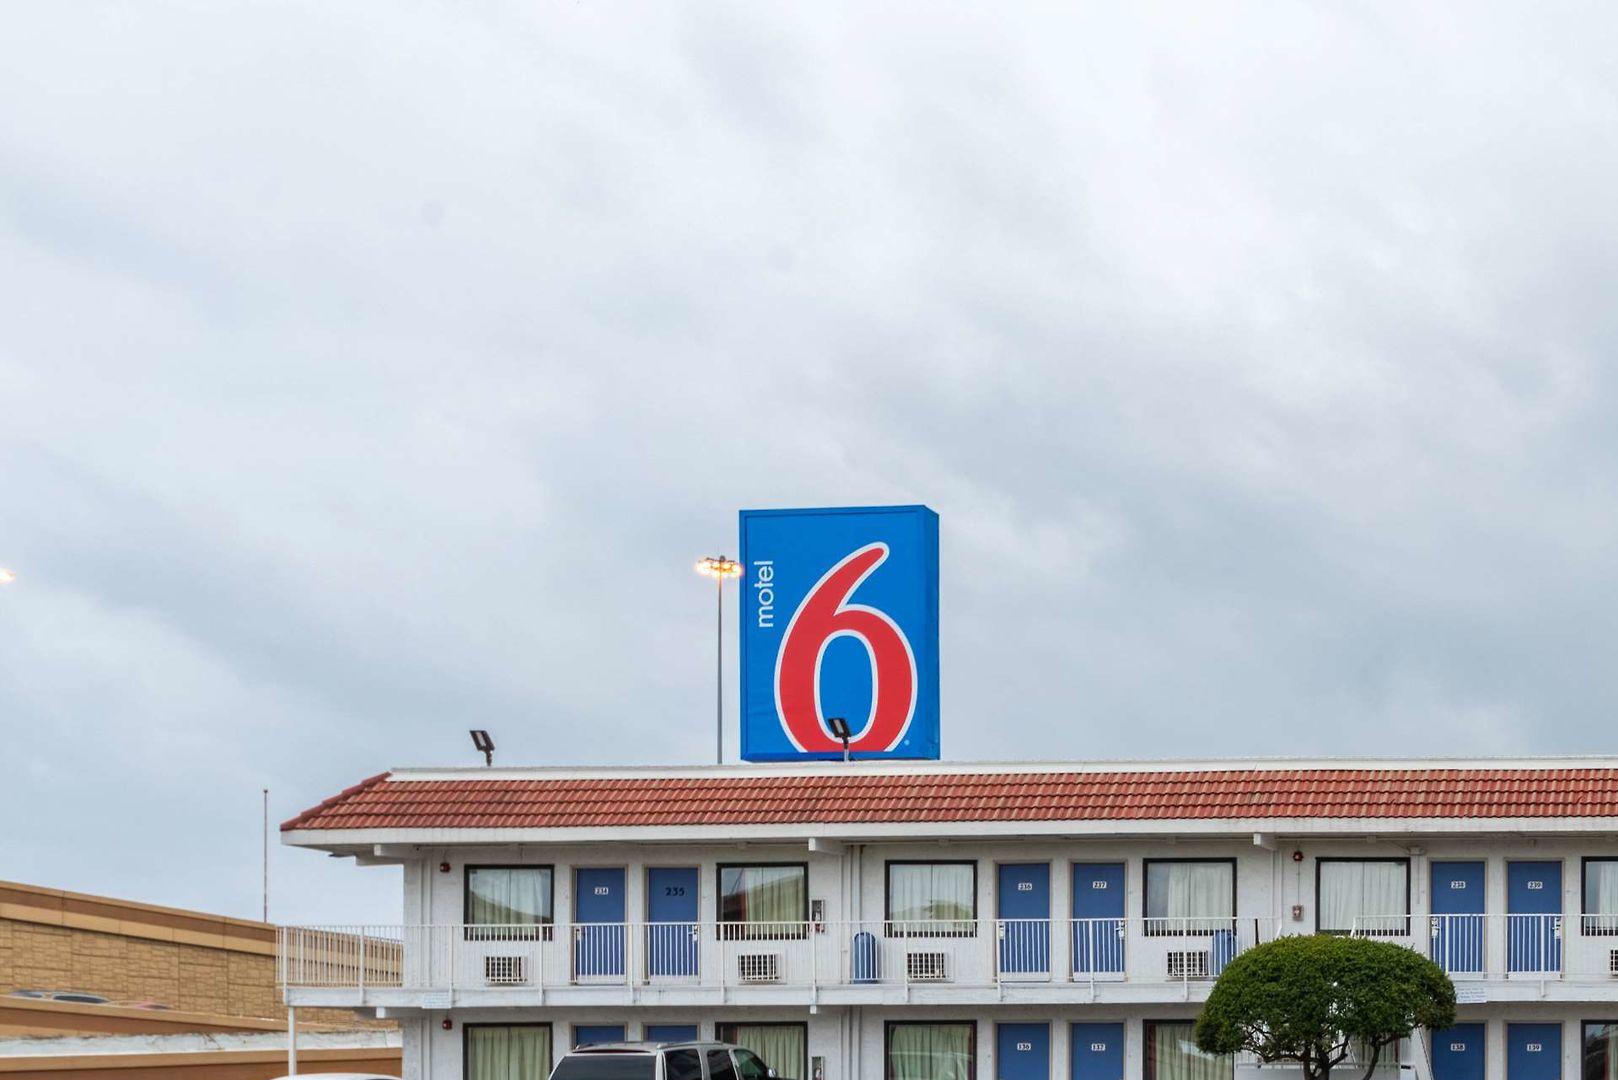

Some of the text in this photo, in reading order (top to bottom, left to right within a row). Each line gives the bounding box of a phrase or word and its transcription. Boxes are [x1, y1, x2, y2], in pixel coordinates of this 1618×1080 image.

[754, 541, 918, 752] motel 6
[665, 887, 685, 896] 235
